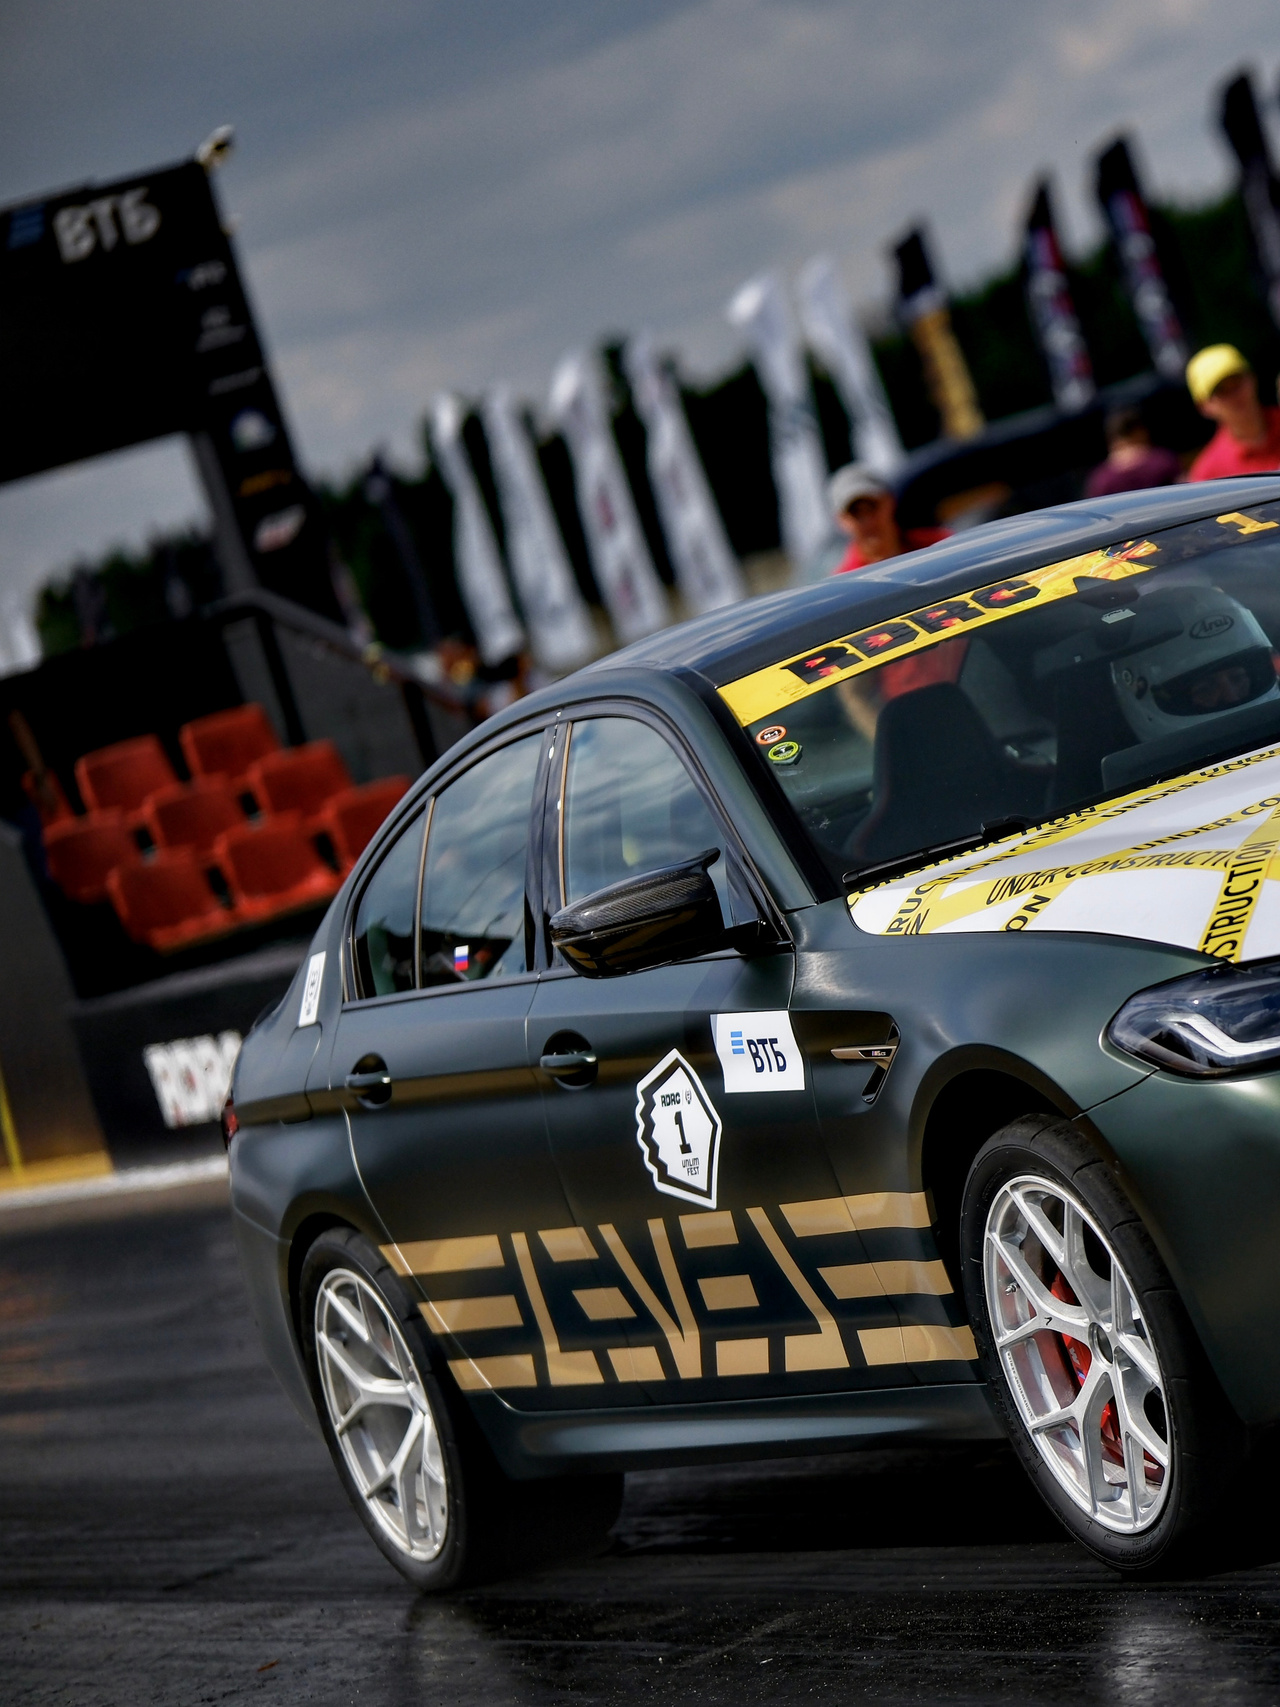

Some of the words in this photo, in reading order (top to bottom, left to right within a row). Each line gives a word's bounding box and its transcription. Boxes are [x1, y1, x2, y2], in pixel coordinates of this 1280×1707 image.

[1131, 816, 1237, 851] UNDER
[987, 866, 1071, 905] UNDER
[746, 1038, 787, 1073] ВТБ
[661, 1092, 681, 1108] RDRC
[674, 1110, 692, 1154] 1
